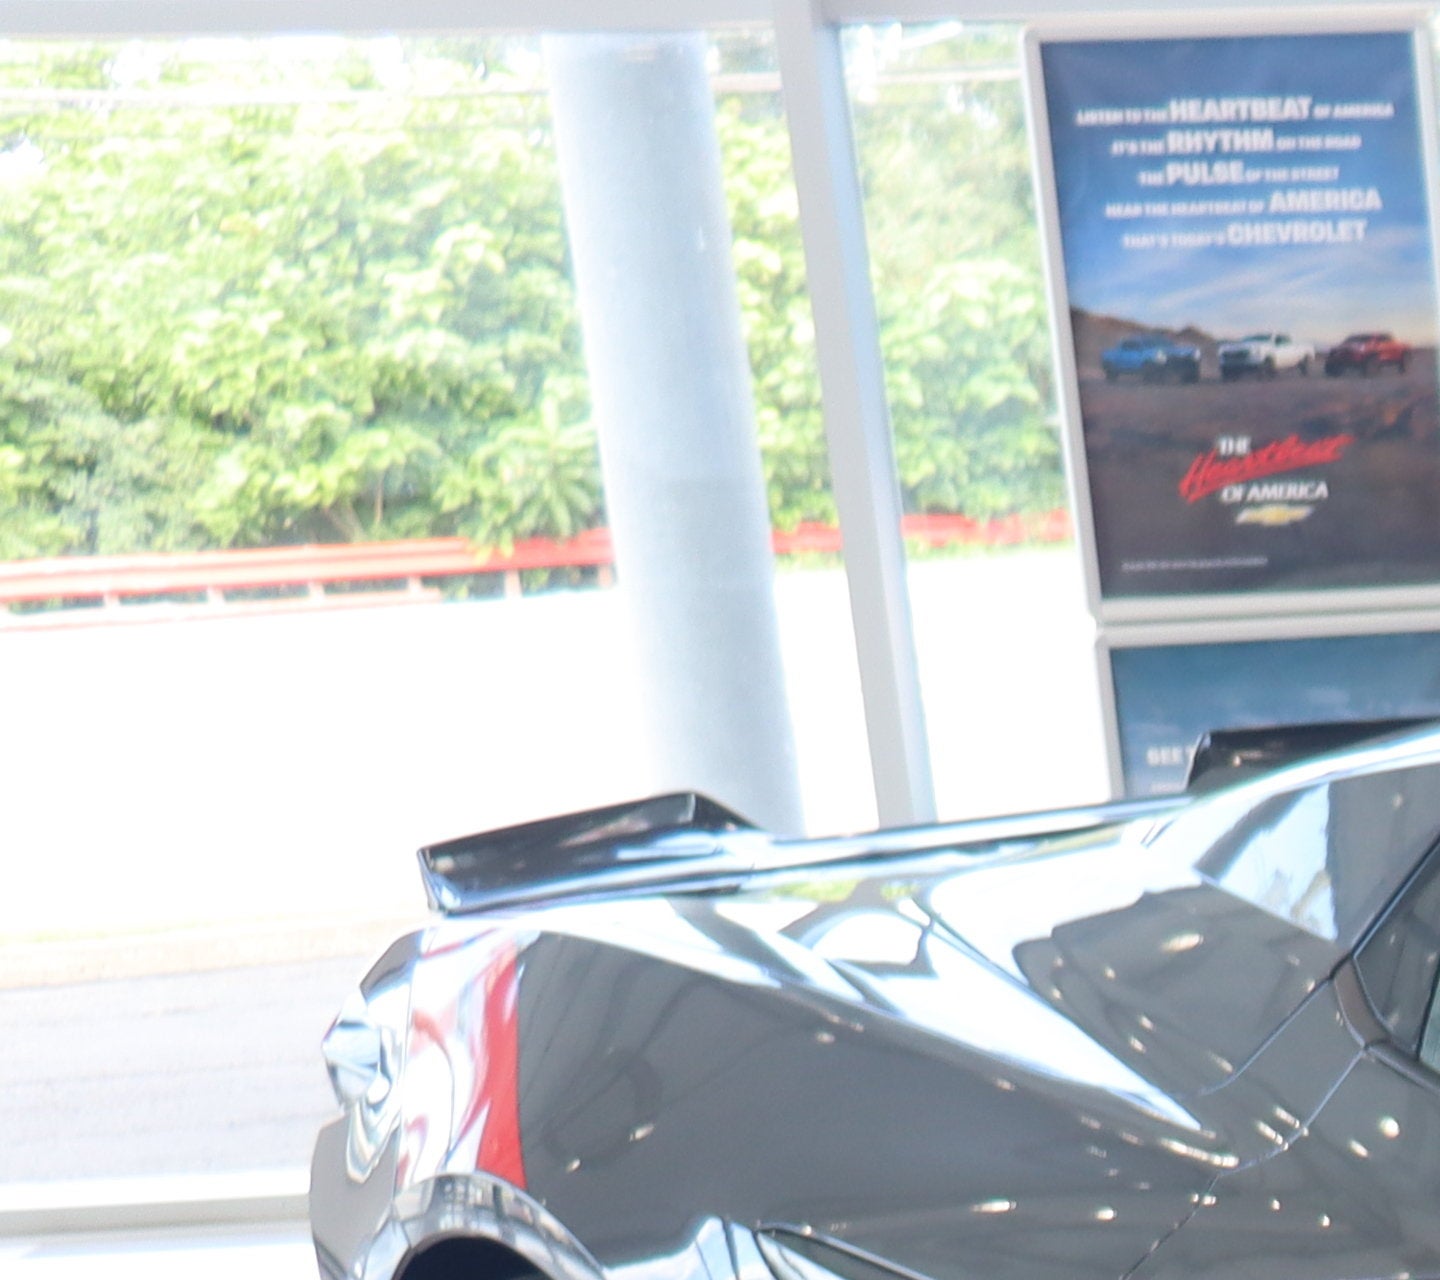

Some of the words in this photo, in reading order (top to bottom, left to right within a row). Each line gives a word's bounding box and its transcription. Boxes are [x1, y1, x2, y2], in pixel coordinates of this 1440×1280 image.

[1169, 96, 1313, 122] HEARTBEAT
[1167, 128, 1274, 153] RHYTHM
[1166, 161, 1244, 186] PULSE
[1268, 188, 1382, 213] AMERICA
[1227, 218, 1368, 246] CHEVROLET
[1247, 481, 1328, 501] AMERICA
